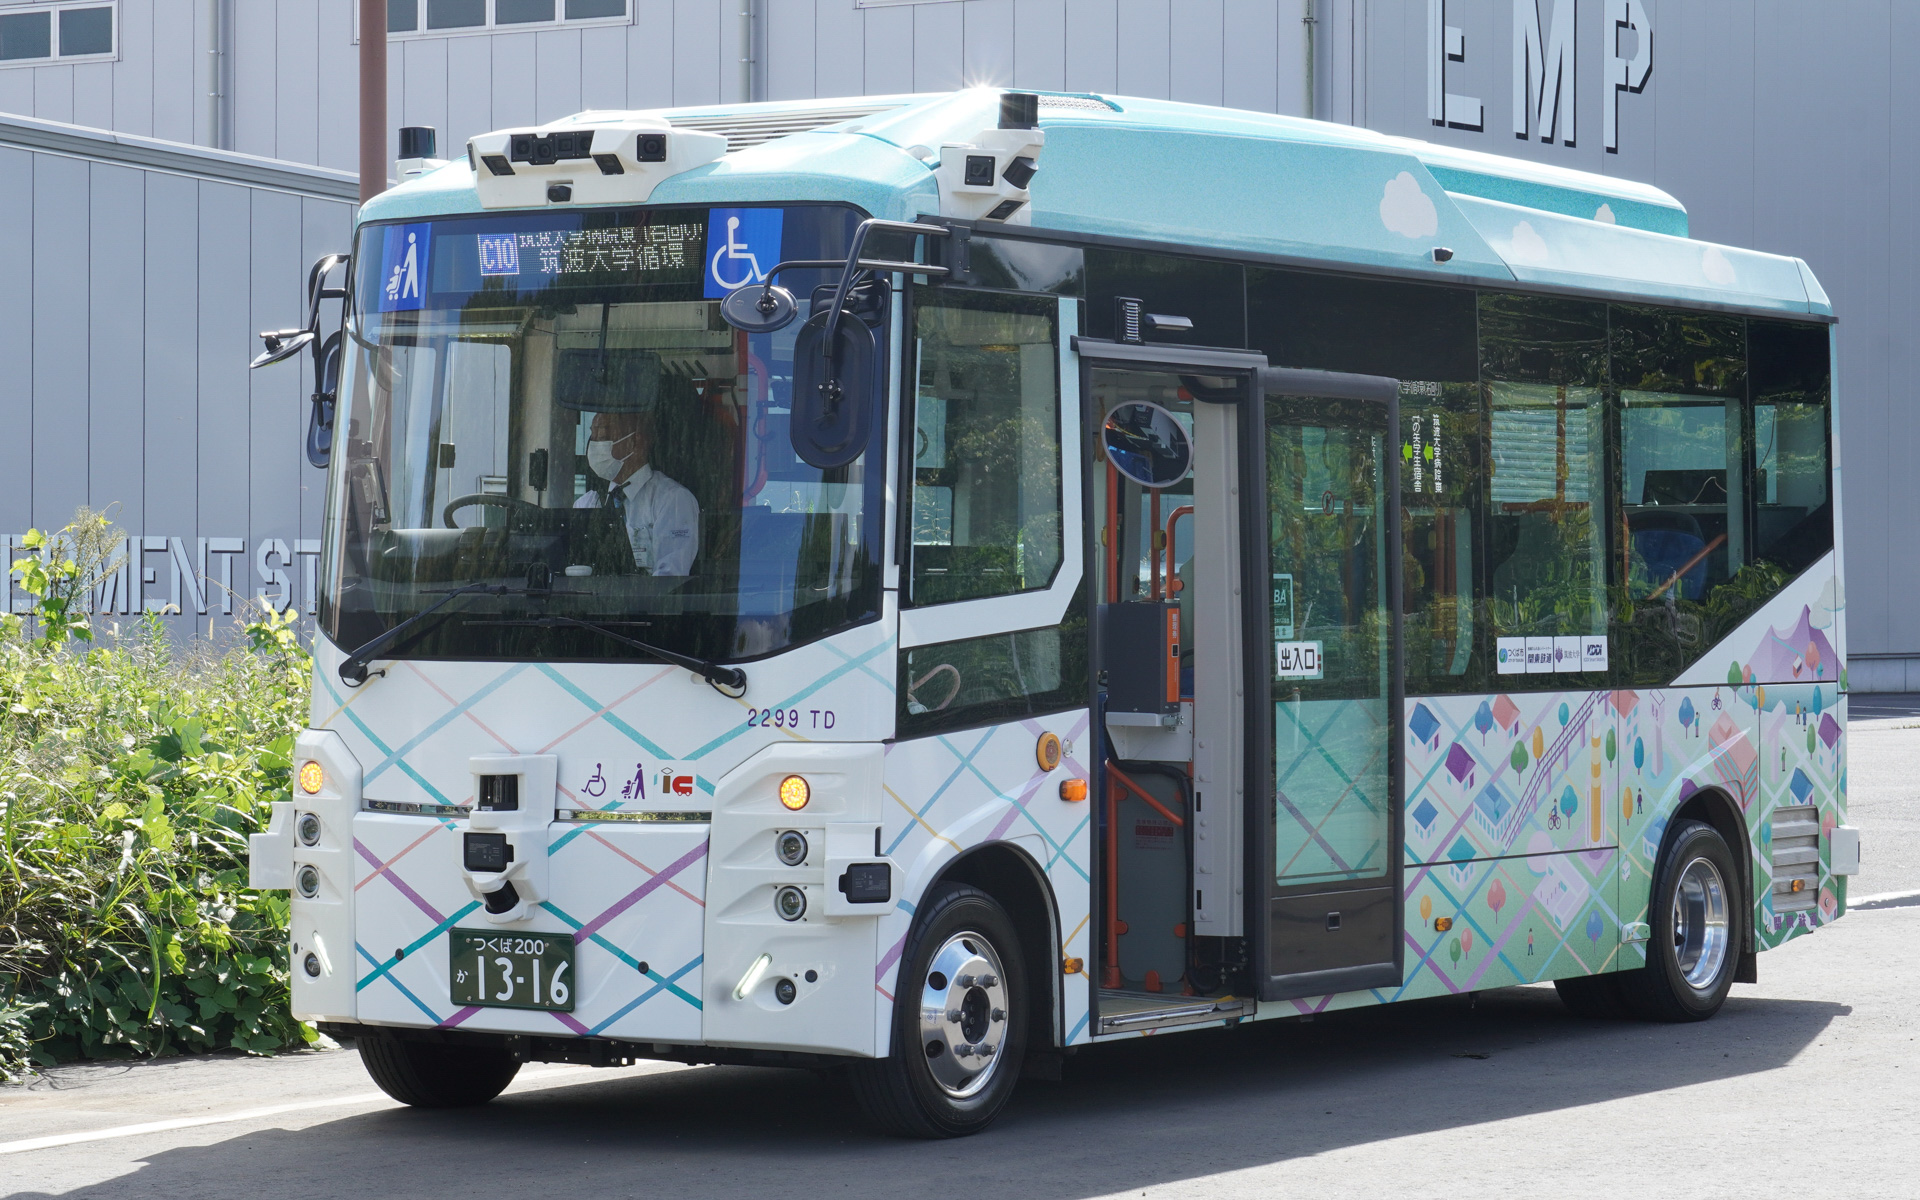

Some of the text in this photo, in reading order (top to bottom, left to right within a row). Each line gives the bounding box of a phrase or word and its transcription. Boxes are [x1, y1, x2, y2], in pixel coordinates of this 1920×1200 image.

[480, 238, 514, 270] C10
[539, 242, 685, 275] 筑波大学循環
[1280, 647, 1315, 670] 出入口
[1587, 644, 1602, 656] KDDI
[748, 708, 836, 729] 2299 TD
[456, 969, 469, 984] か
[477, 955, 569, 1005] 13-16
